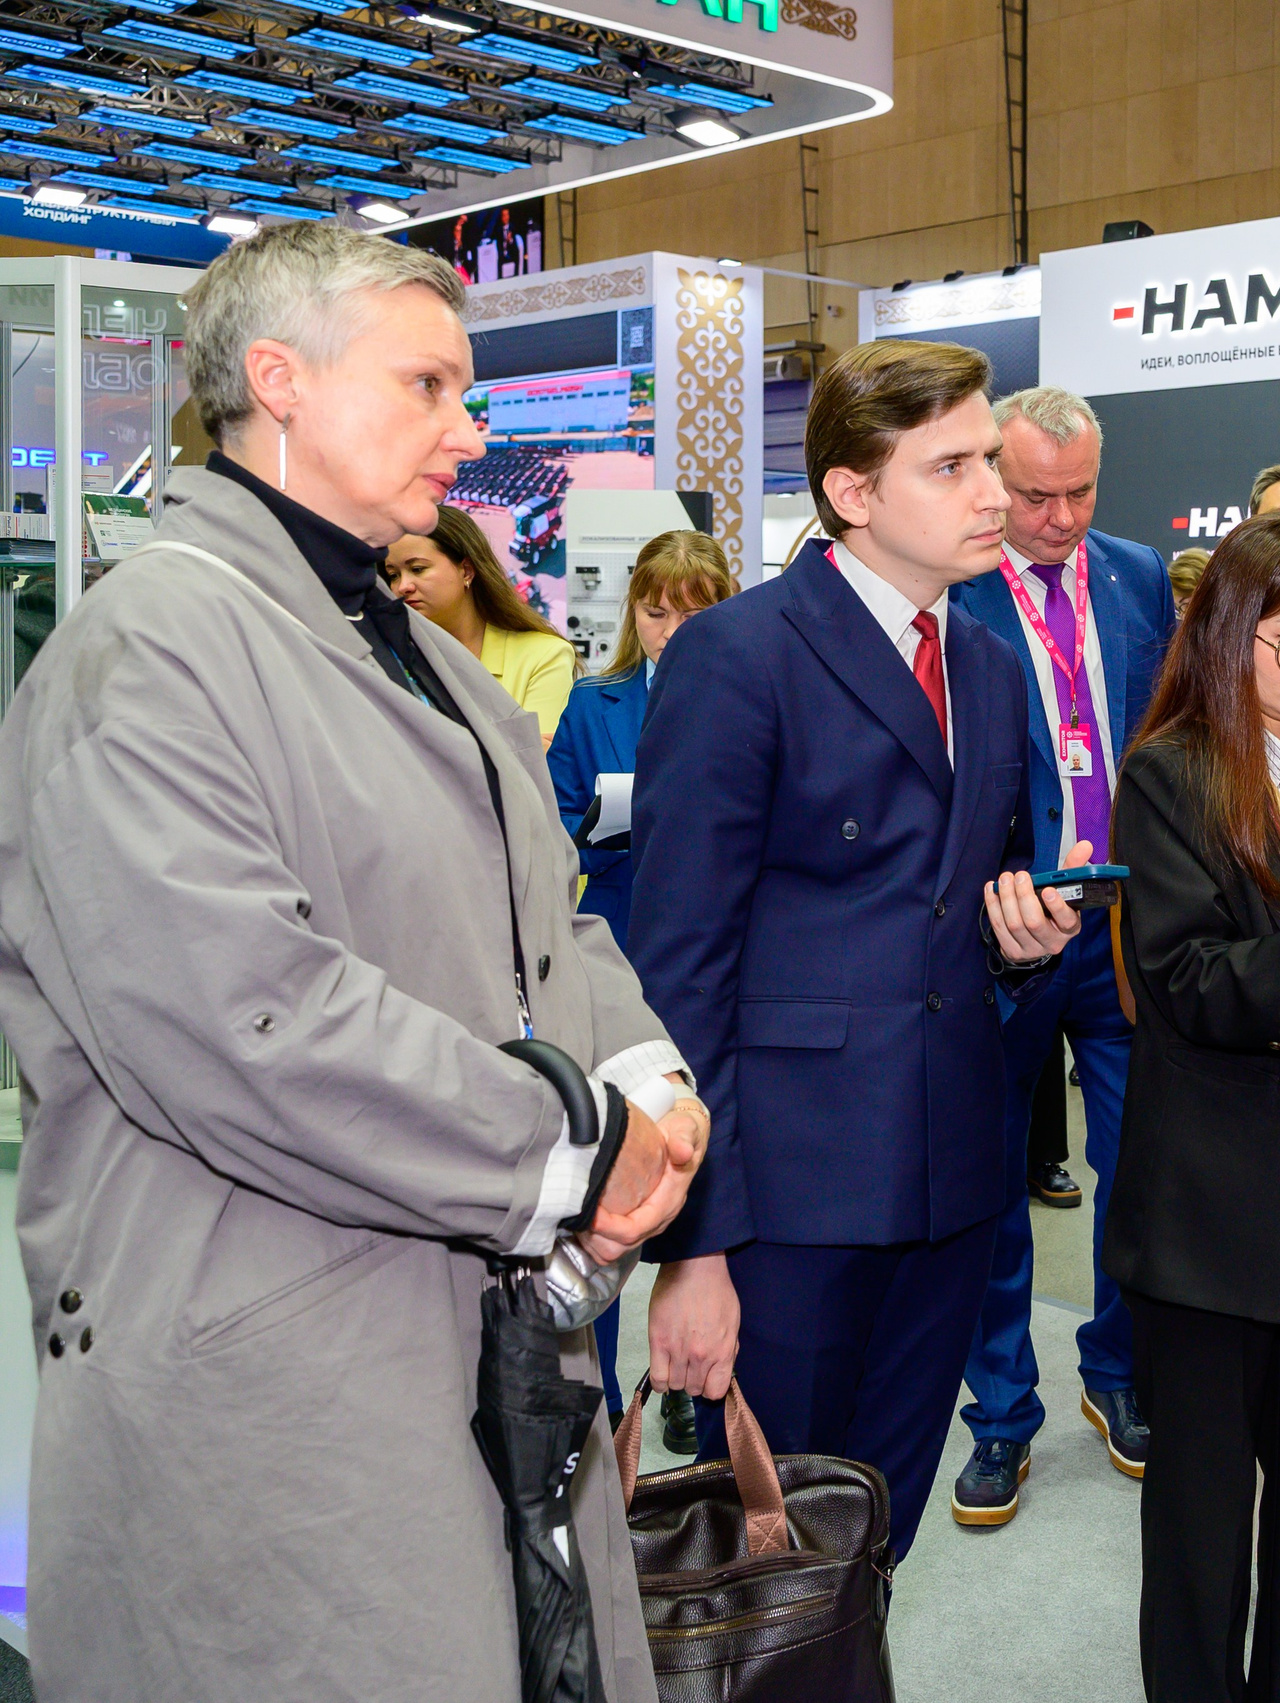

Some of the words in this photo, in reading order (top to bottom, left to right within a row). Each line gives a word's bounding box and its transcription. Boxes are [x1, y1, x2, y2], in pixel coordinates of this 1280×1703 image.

[23, 206, 92, 224] ХОЛДИНГ
[1141, 357, 1175, 370] ИДЕИ,
[1178, 345, 1276, 366] ВОПЛОЩЁННЫЕ
[1188, 506, 1252, 538] НА
